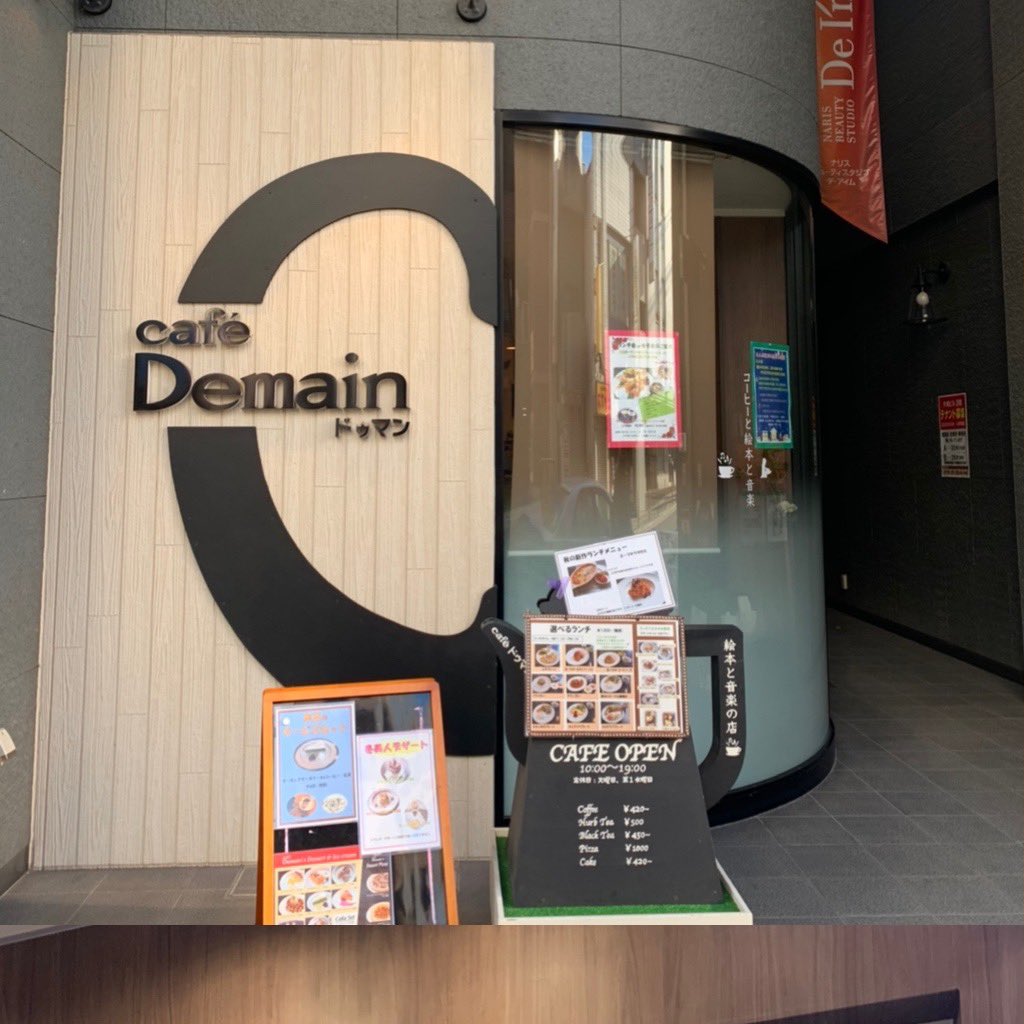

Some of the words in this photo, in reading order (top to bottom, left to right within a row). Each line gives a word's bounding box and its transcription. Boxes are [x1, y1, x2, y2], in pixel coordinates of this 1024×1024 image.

[823, 106, 832, 143] NARIS
[835, 96, 844, 143] BEAUTY
[847, 99, 856, 144] STUDIO
[136, 308, 251, 347] café
[133, 352, 410, 412] Demain
[723, 639, 738, 734] 絵本と音楽の店
[550, 743, 610, 763] CAFE
[615, 739, 682, 762] OPEN
